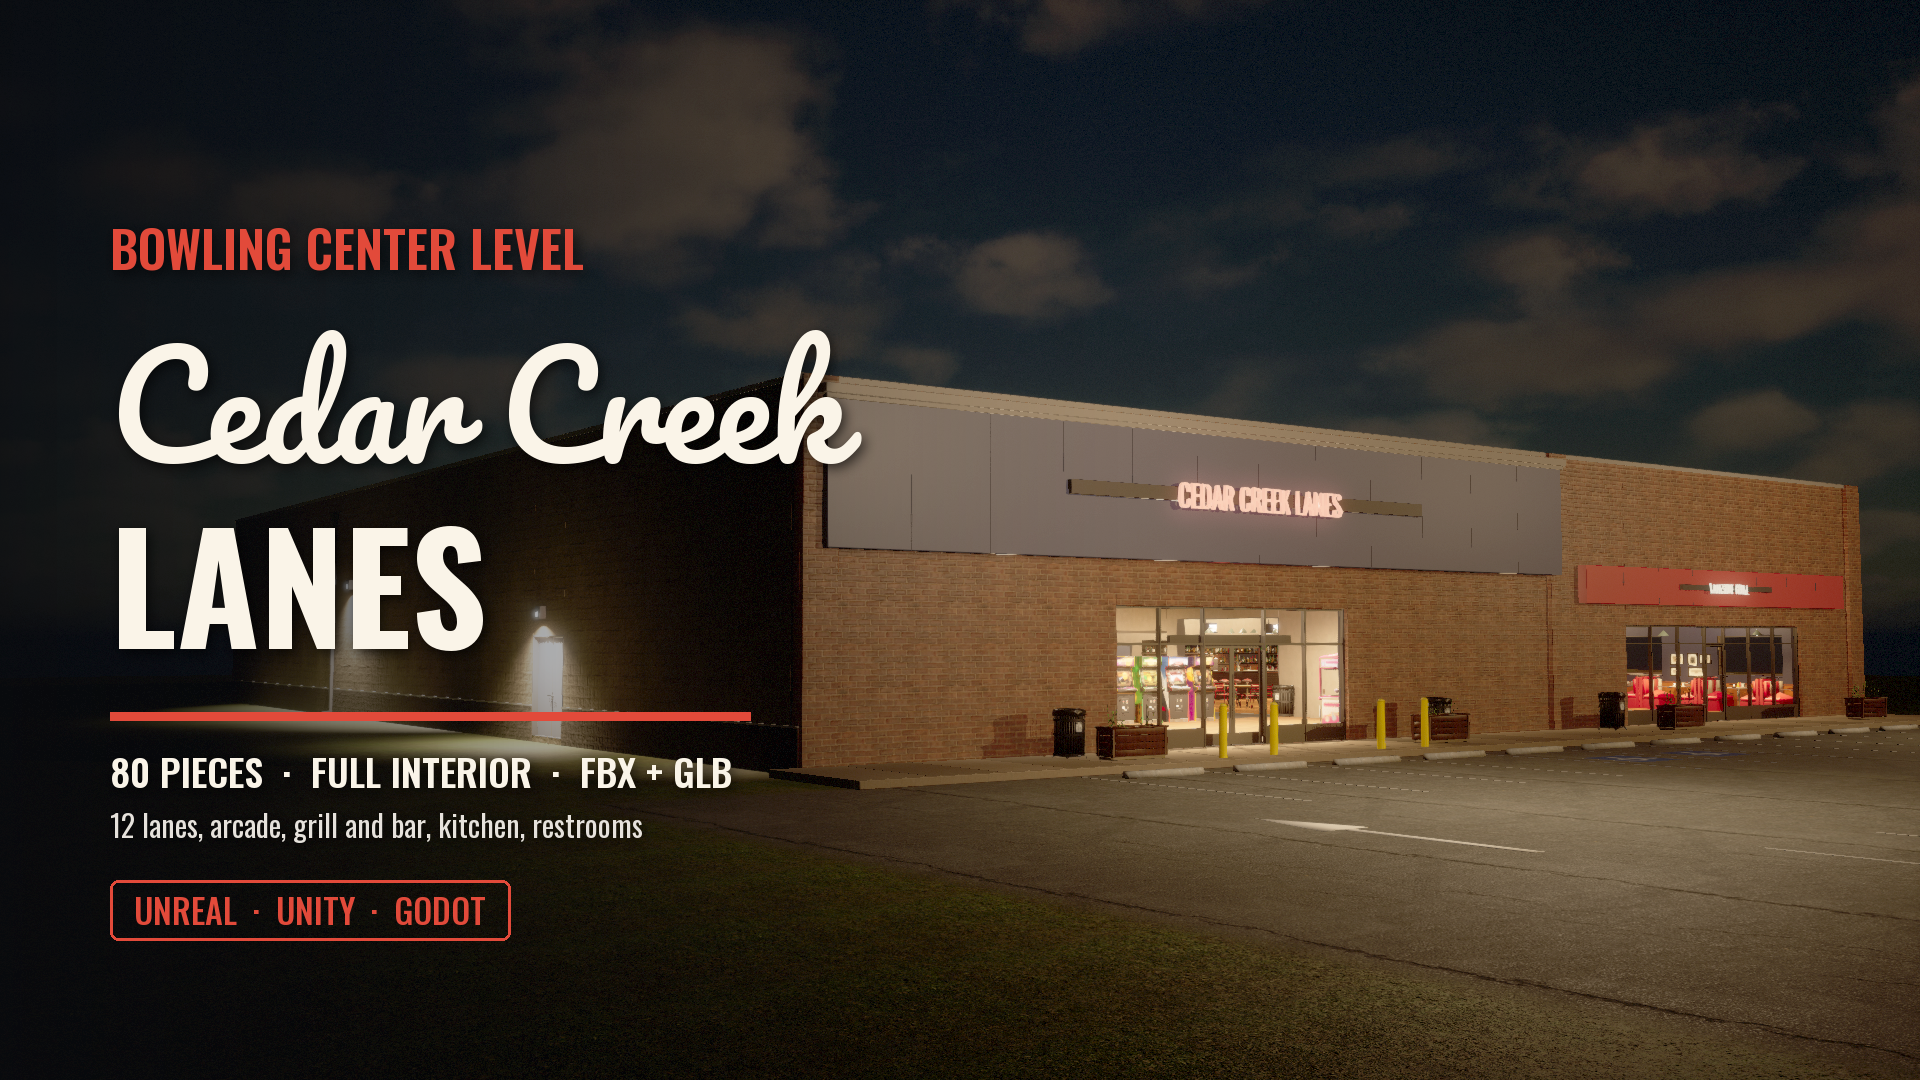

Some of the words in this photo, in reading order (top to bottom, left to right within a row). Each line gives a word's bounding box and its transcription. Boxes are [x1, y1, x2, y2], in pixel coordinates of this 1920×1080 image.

[1177, 481, 1235, 511] CEDAR
[1239, 486, 1291, 515] CREEK
[1294, 490, 1343, 518] LANES
